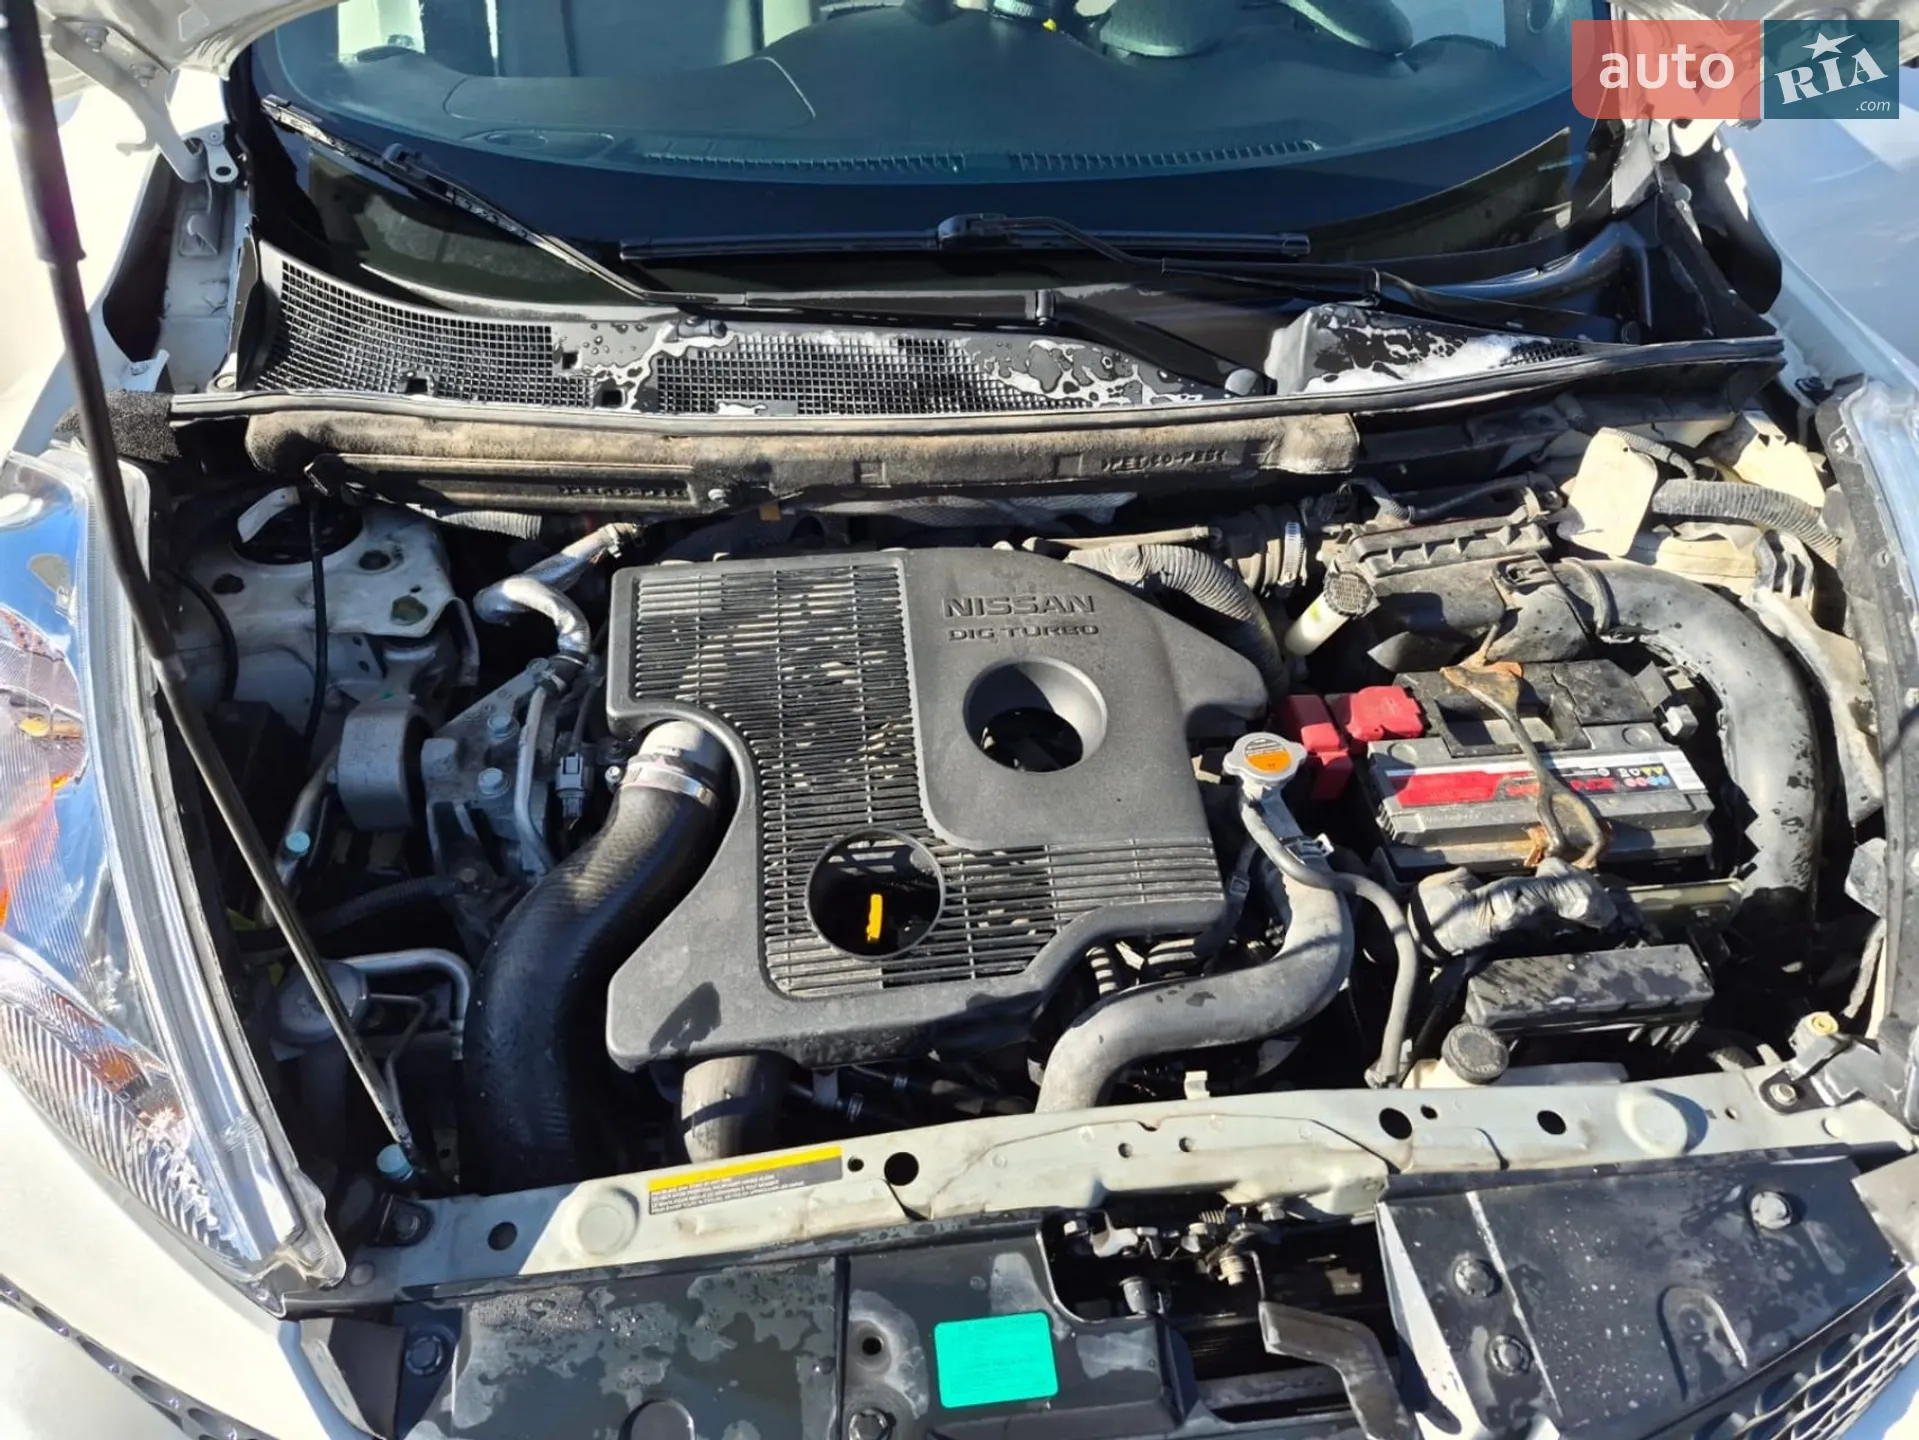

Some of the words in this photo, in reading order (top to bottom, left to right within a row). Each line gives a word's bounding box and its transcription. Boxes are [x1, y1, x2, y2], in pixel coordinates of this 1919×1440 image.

[942, 595, 1096, 618] NISSAN
[949, 627, 995, 641] DIG
[1001, 624, 1099, 638] TURBO
